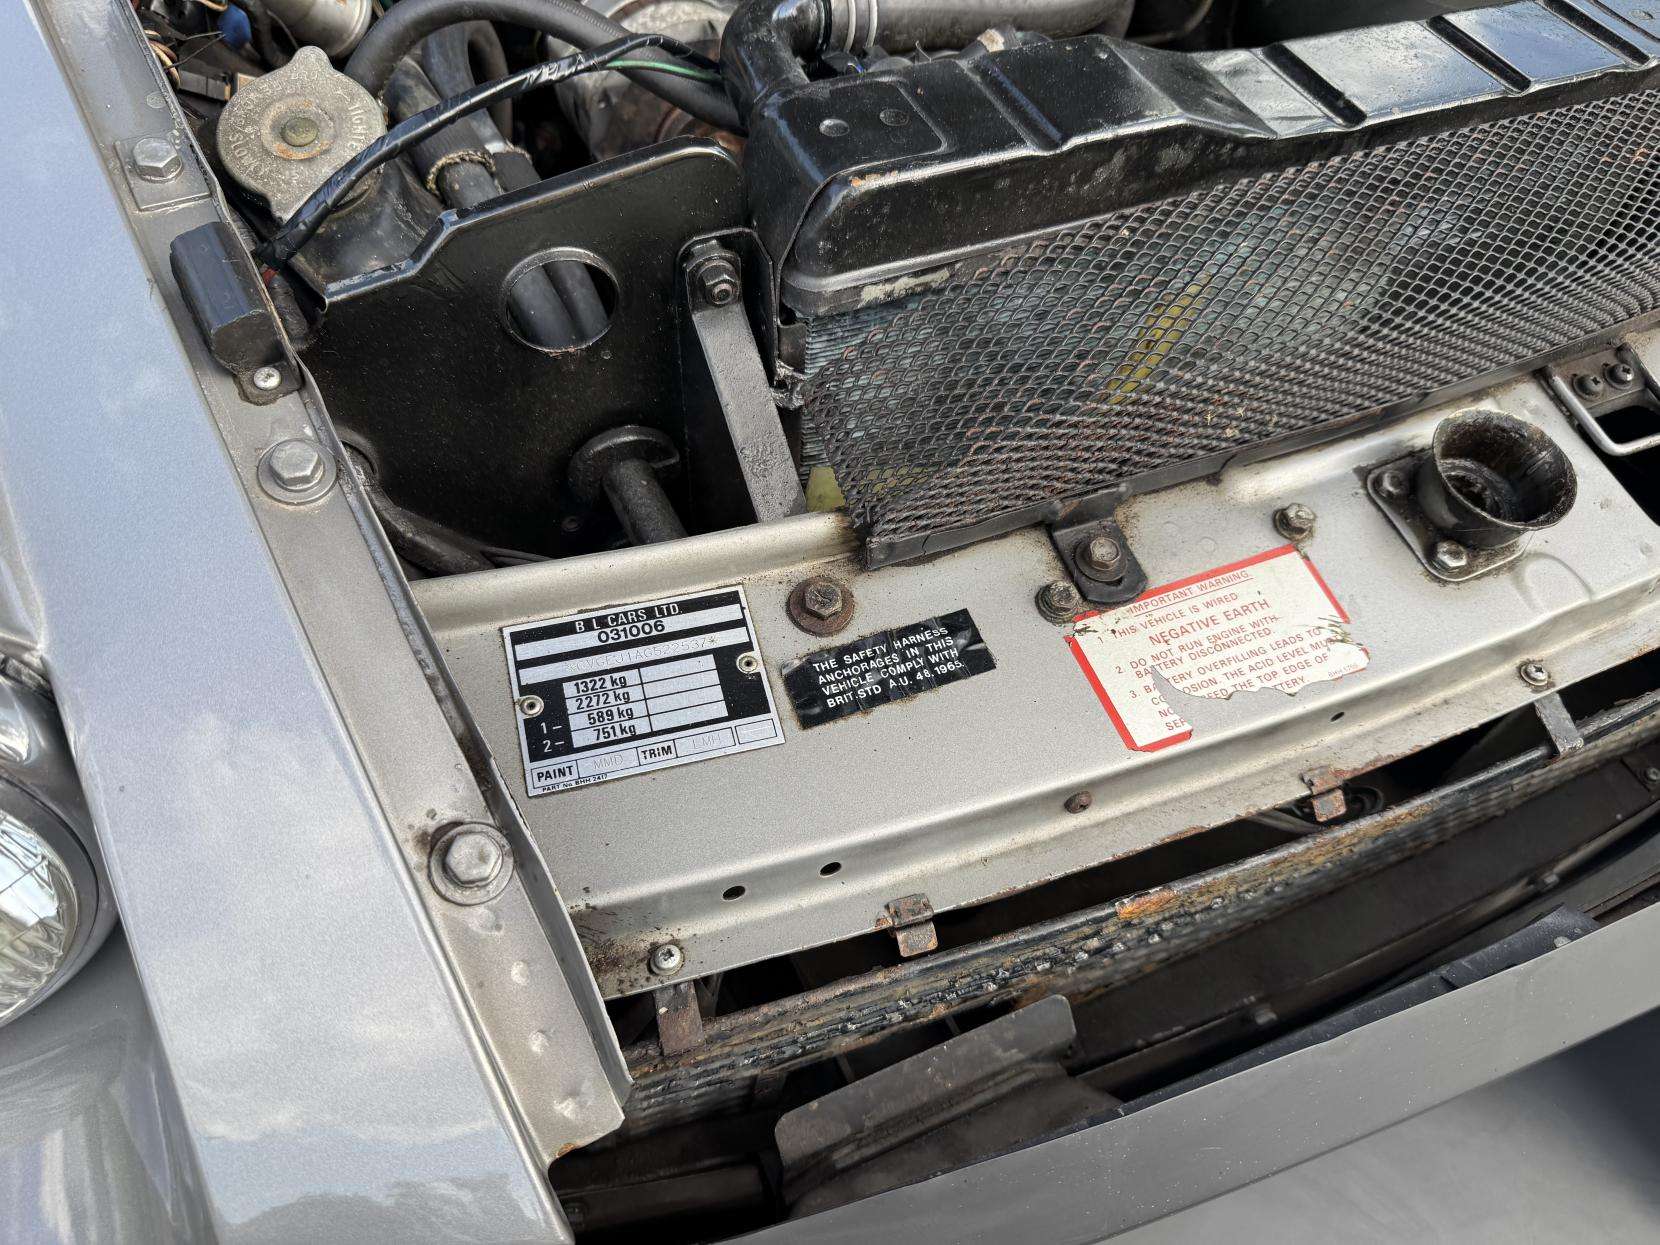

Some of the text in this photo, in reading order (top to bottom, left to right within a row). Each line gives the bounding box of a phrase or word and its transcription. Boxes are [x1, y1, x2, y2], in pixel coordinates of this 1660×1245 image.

[1129, 570, 1250, 614] IMPORTANT WARNING
[1139, 610, 1188, 630] VEHICLE
[1190, 604, 1200, 615] IS
[1202, 592, 1239, 609] WIRED
[575, 603, 684, 634] B L CARS LTD.
[597, 620, 666, 643] 031006
[1148, 599, 1271, 646] NEGATIVE EARTH
[813, 627, 949, 673] THE SAFETY HARNESS
[818, 636, 954, 684] ANCHORAGES IN THIS
[1130, 658, 1147, 669] DO
[1150, 648, 1174, 662] NOT
[1178, 638, 1204, 653] RUN
[1206, 624, 1247, 644] ENGINE
[1250, 614, 1280, 629] WITH
[1135, 627, 1276, 679] BATERY DISCONNECTED.
[1197, 646, 1268, 675] OVERFILLING
[1269, 634, 1305, 651] LEADS
[1306, 628, 1322, 638] TO
[822, 648, 959, 696] VEHICLE COMPLY WITH
[1222, 670, 1247, 681] THE
[1248, 658, 1275, 673] ACID
[1276, 646, 1308, 663] LEVEL
[1231, 679, 1256, 691] THE
[1256, 670, 1279, 684] TOP
[1283, 659, 1313, 675] EDGE
[1315, 653, 1330, 664] OF
[574, 675, 628, 694] 1322 kg
[575, 690, 631, 711] 2272 kg
[889, 677, 913, 690] A.U.
[587, 709, 615, 726] 589
[616, 706, 635, 719] kg
[593, 726, 617, 741] 751
[618, 723, 637, 736] kg
[537, 765, 574, 783] PAINT
[641, 745, 673, 760] TRIM
[542, 784, 561, 793] PART
